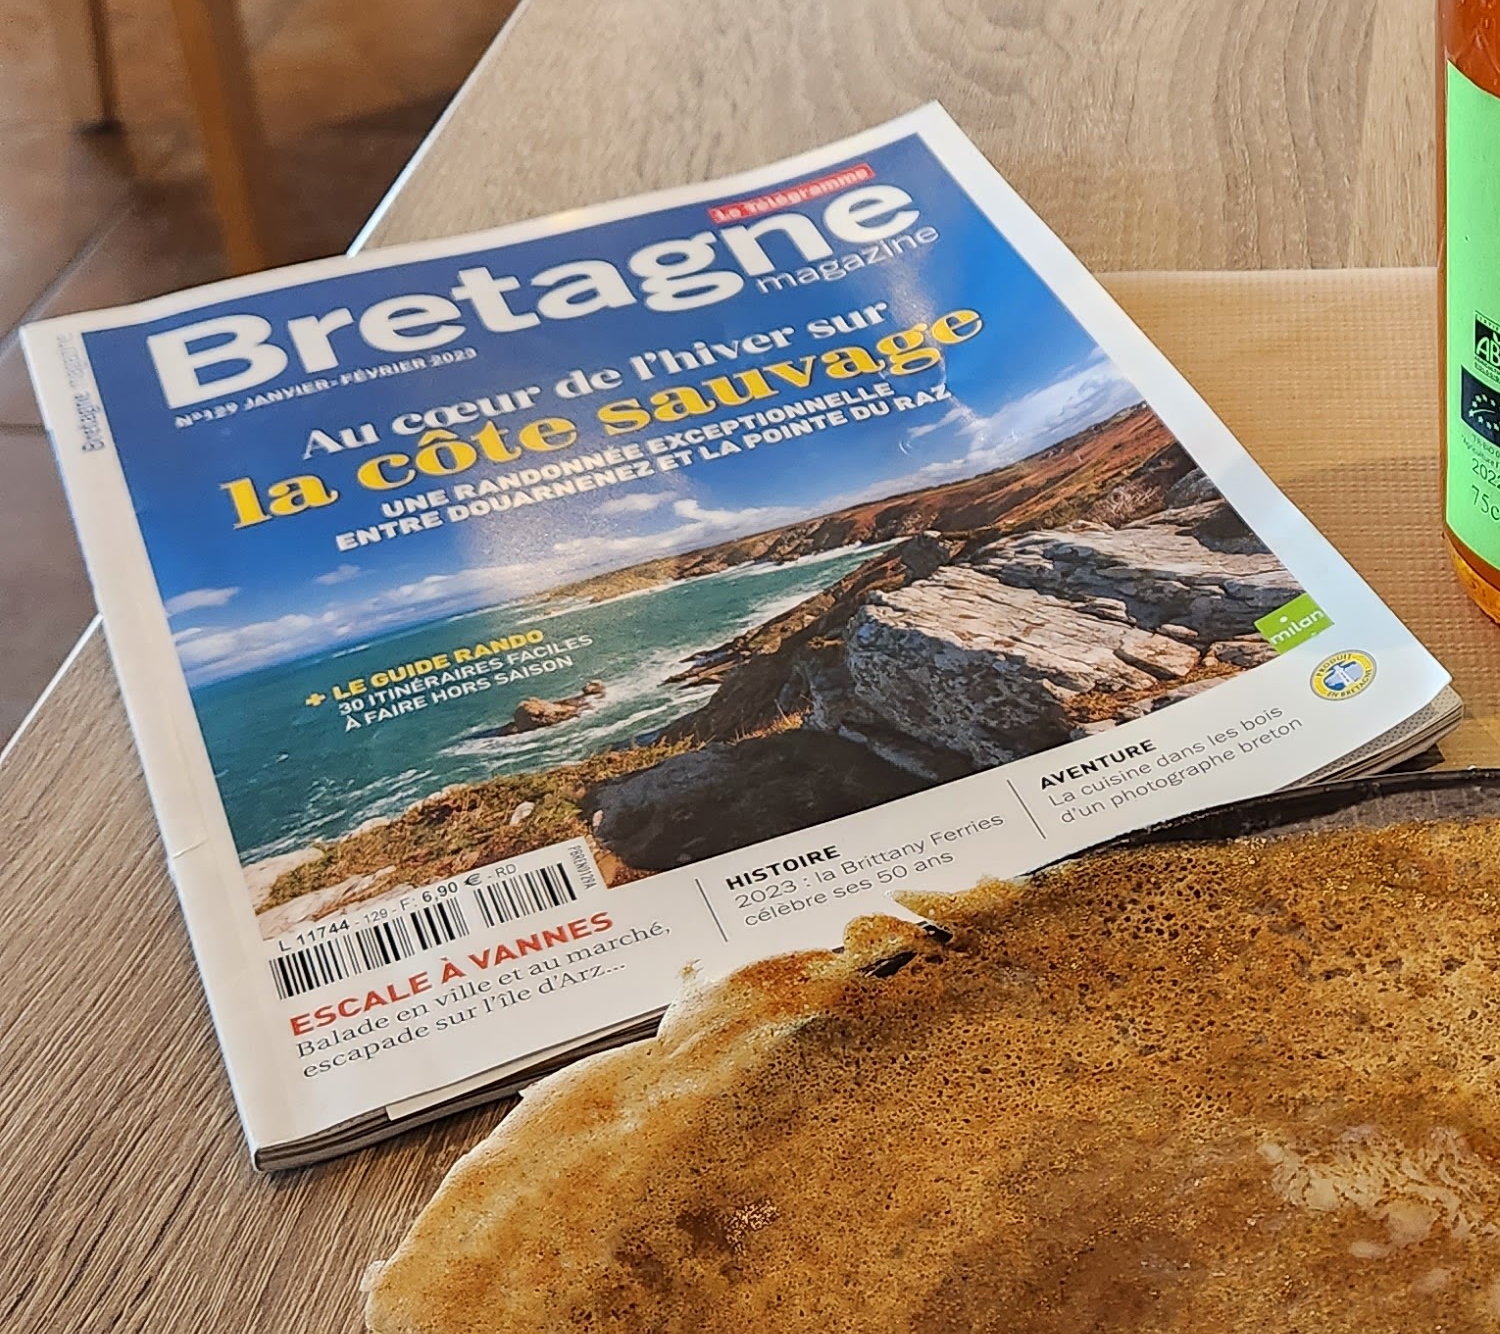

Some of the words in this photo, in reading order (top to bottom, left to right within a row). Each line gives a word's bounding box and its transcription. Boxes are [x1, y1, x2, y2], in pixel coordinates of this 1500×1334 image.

[147, 184, 920, 409] Bretagne
[755, 225, 940, 294] magazine
[219, 474, 340, 531] la
[357, 416, 578, 491] côte
[597, 308, 984, 437] sauvage
[303, 422, 380, 460] Au
[392, 383, 541, 436] cœur
[554, 368, 623, 400] de
[807, 301, 888, 340] sur
[336, 510, 444, 552] ENTRE
[449, 455, 655, 524] DOUARNENEZ
[656, 447, 695, 473] ET
[698, 437, 743, 461] LA
[742, 411, 849, 450] POINTE
[855, 400, 892, 422] DU
[896, 383, 952, 413] RAZ
[381, 489, 450, 519] UNE
[451, 441, 642, 501] RANDONNÉE
[650, 381, 897, 456] EXCEPTIONNELLE
[332, 677, 367, 701] LE
[370, 654, 451, 689] GUIDE
[453, 629, 545, 664] RANDO
[1270, 610, 1325, 646] milan
[1315, 653, 1352, 678] PRODUIT
[339, 698, 365, 716] 30
[368, 657, 505, 708] ITINÉRAIRES
[506, 634, 594, 667] FACILES
[345, 715, 362, 733] À
[364, 694, 429, 720] FAIRE
[430, 678, 491, 705] HORS
[493, 654, 574, 685] SAISON
[1039, 739, 1157, 791] AVENTURE
[1047, 784, 1077, 807] La
[1082, 759, 1152, 797] cuisine
[1156, 741, 1205, 769] dans
[1207, 725, 1239, 748] les
[1240, 705, 1284, 733] bois
[1109, 747, 1237, 811] photographe
[1240, 717, 1303, 757] breton
[725, 844, 842, 891] HISTOIRE
[734, 879, 798, 909] 2023
[814, 866, 837, 884] la
[840, 837, 926, 876] Brittany
[929, 814, 1005, 846] Ferries
[744, 891, 828, 927] célèbre
[833, 879, 873, 899] ses
[876, 864, 908, 884] 50
[915, 851, 954, 873] ans
[278, 939, 291, 953] L
[296, 919, 351, 947] 11744
[363, 908, 389, 926] 129
[421, 881, 459, 904] 6,90
[463, 873, 484, 887] €
[495, 863, 518, 878] RD
[289, 971, 434, 1037] ESCALE
[440, 956, 466, 985] À
[468, 911, 615, 970] VANNES
[297, 1012, 390, 1059] Balade
[396, 1002, 429, 1022] en
[434, 979, 492, 1009] ville
[498, 967, 524, 986] et
[528, 955, 561, 976] au
[566, 920, 672, 961] marché,
[303, 1025, 430, 1080] escapade
[435, 1006, 478, 1030] sur
